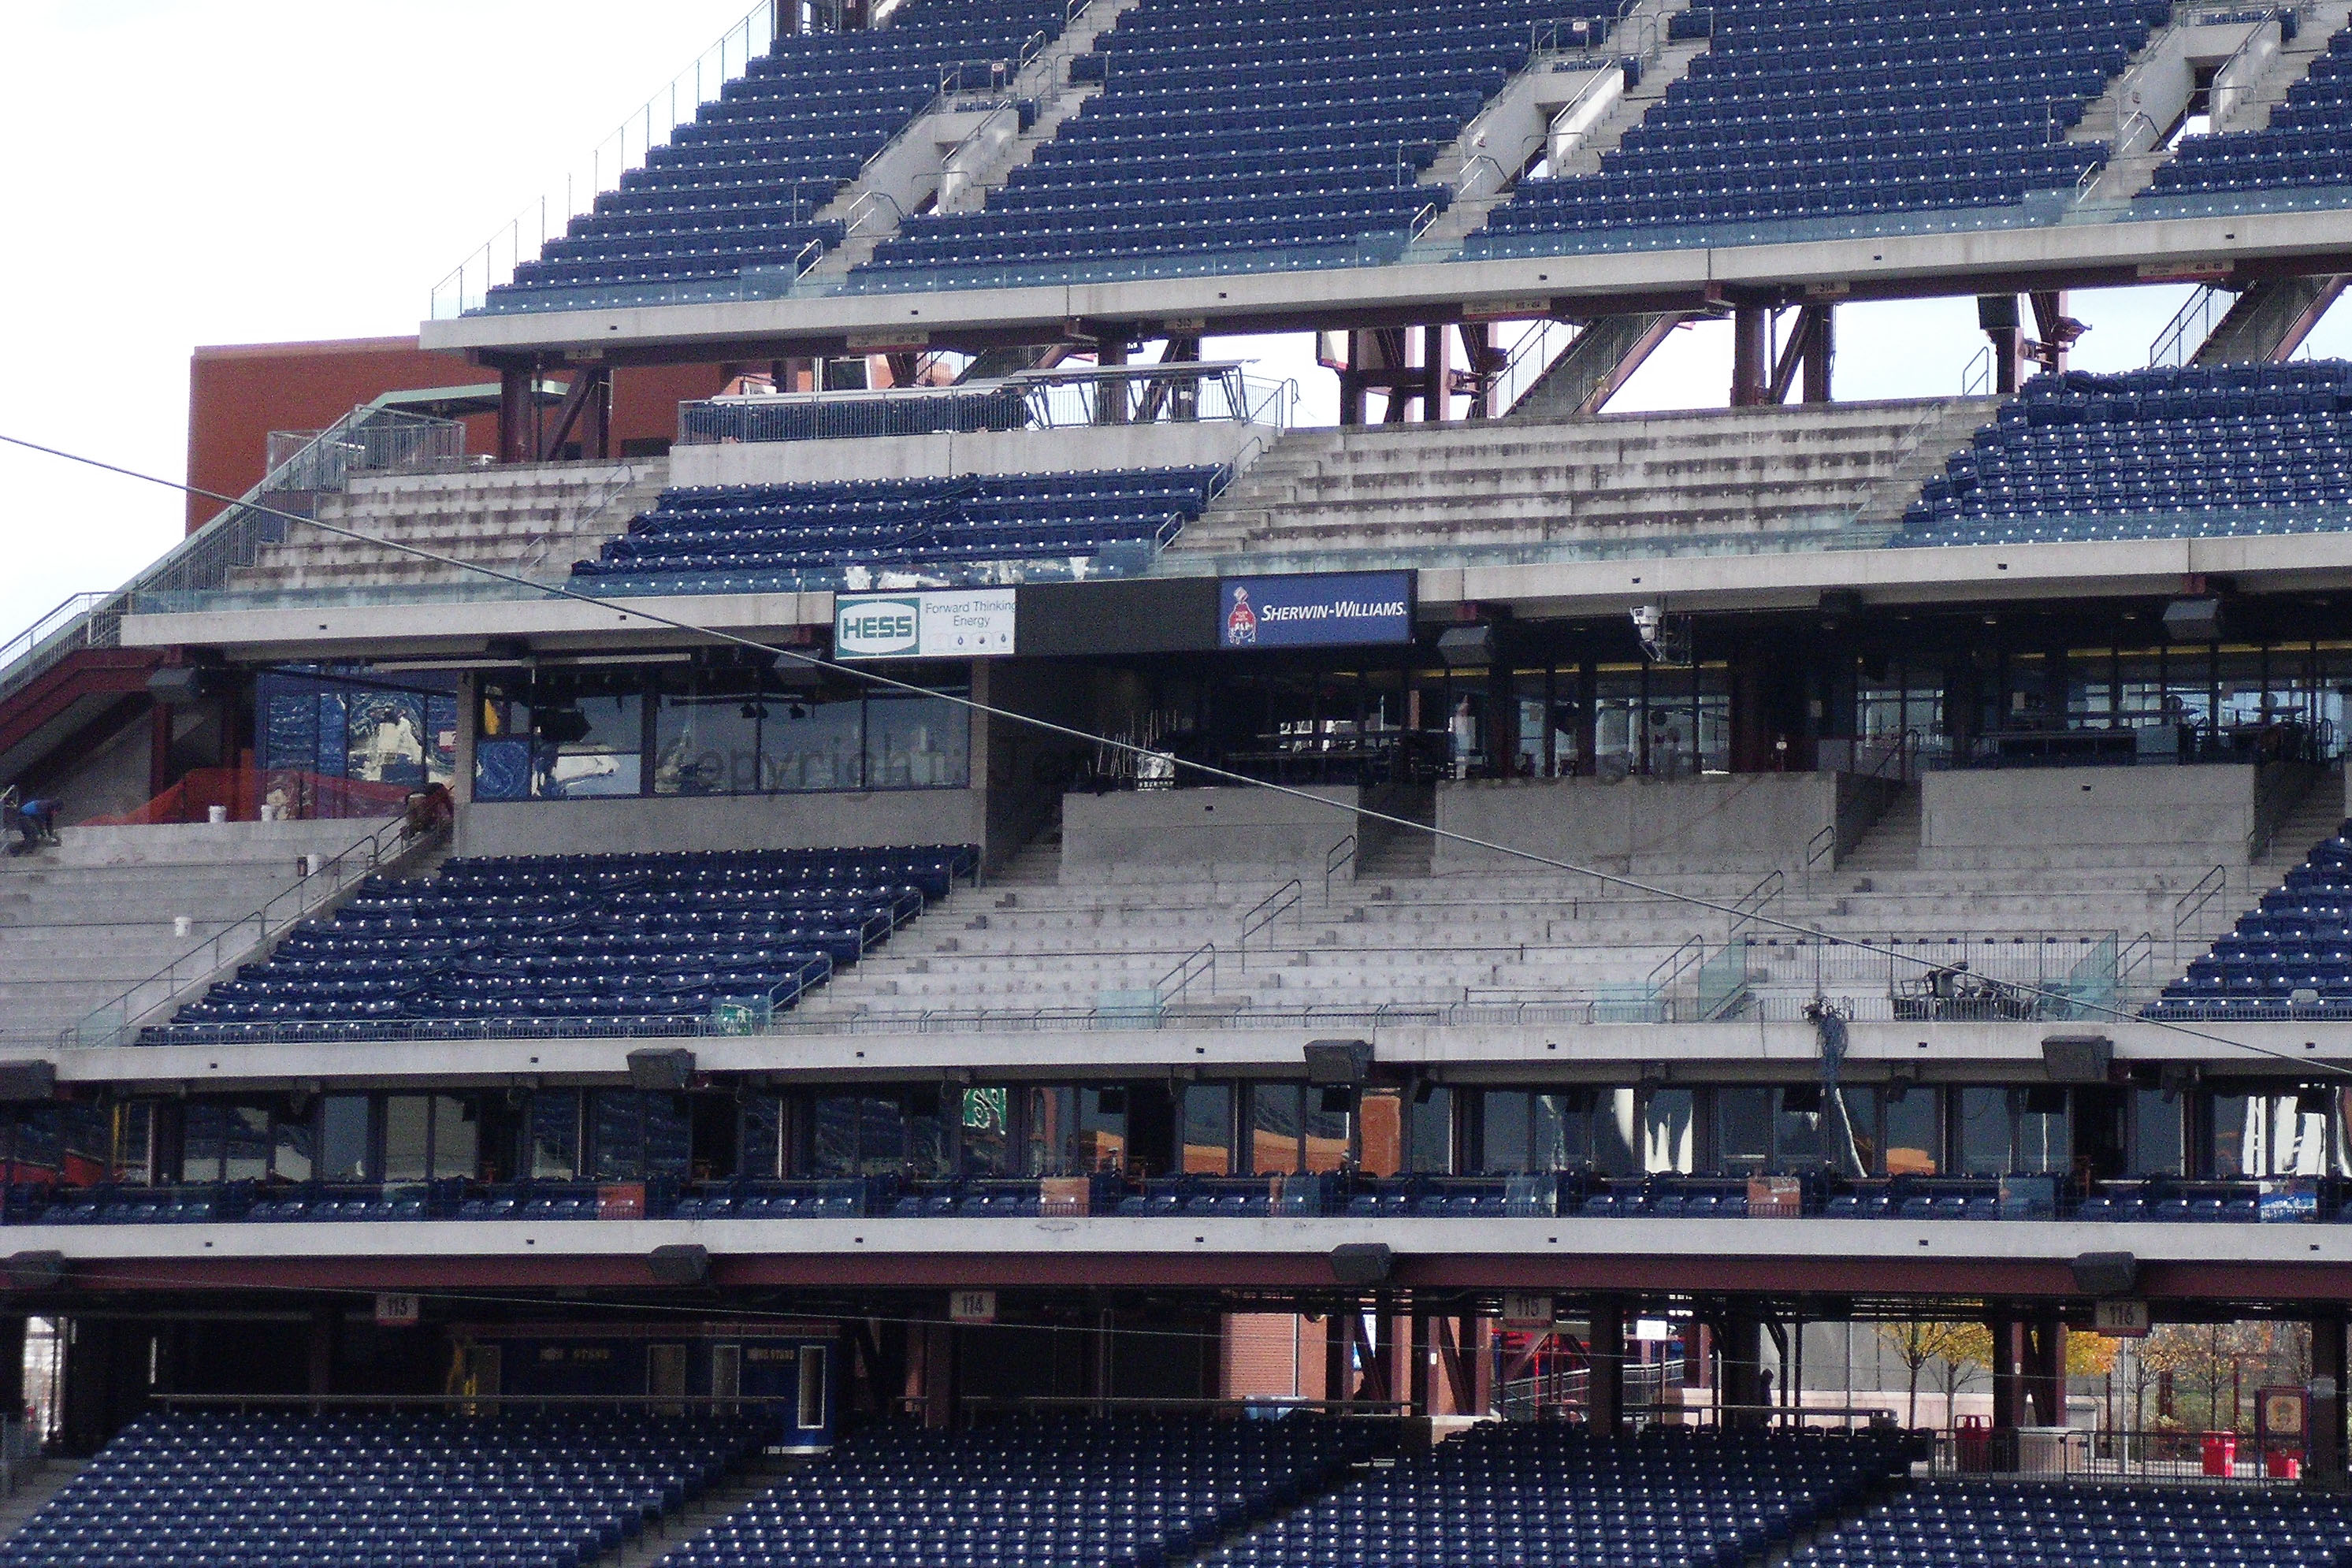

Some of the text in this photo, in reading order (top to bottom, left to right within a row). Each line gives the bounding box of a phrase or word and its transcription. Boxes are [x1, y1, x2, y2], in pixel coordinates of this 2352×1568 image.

[925, 599, 1016, 615] Forward Thinking
[843, 615, 912, 640] HESS
[953, 615, 990, 628] Energy
[388, 1296, 409, 1316] 113
[961, 1295, 984, 1314] 114
[1516, 1297, 1540, 1317] 115
[2109, 1305, 2135, 1325] 116
